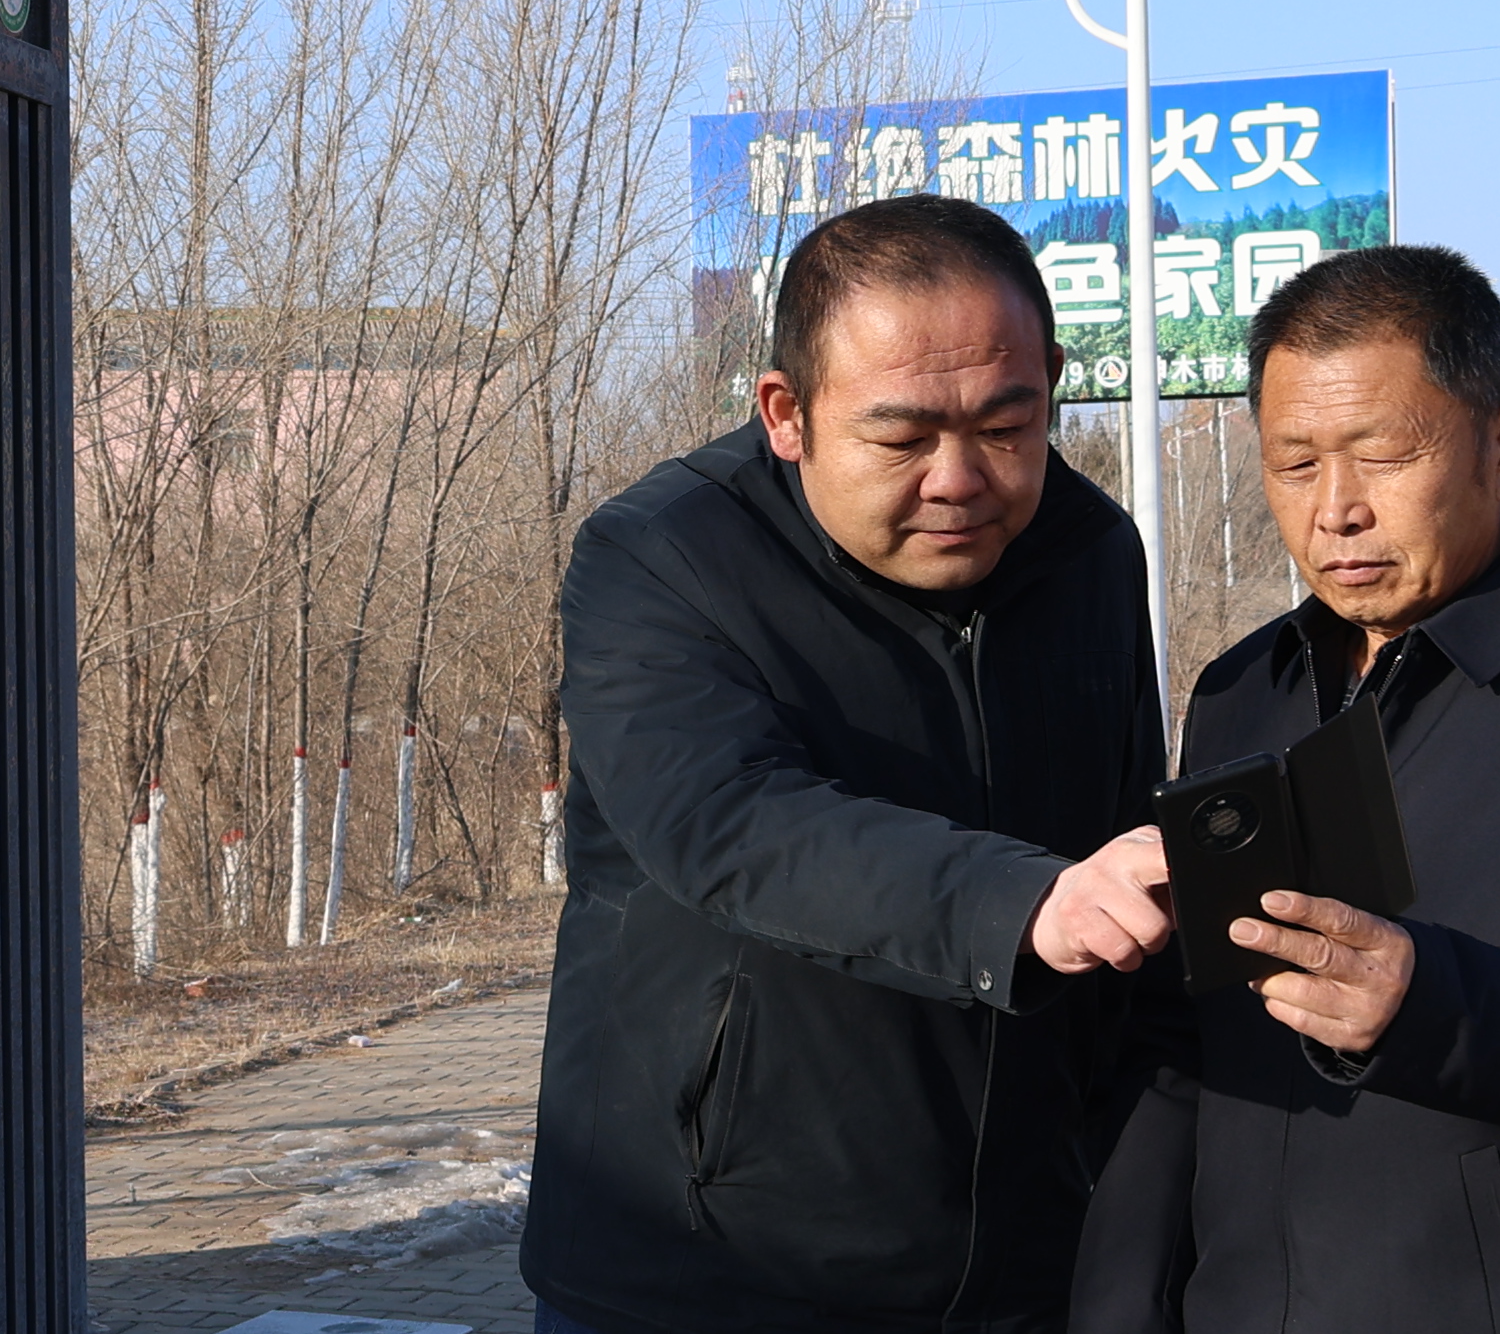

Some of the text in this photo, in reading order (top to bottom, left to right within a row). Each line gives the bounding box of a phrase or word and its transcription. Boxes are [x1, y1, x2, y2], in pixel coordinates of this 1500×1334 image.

[748, 101, 1322, 216] 杜绝森林火灾
